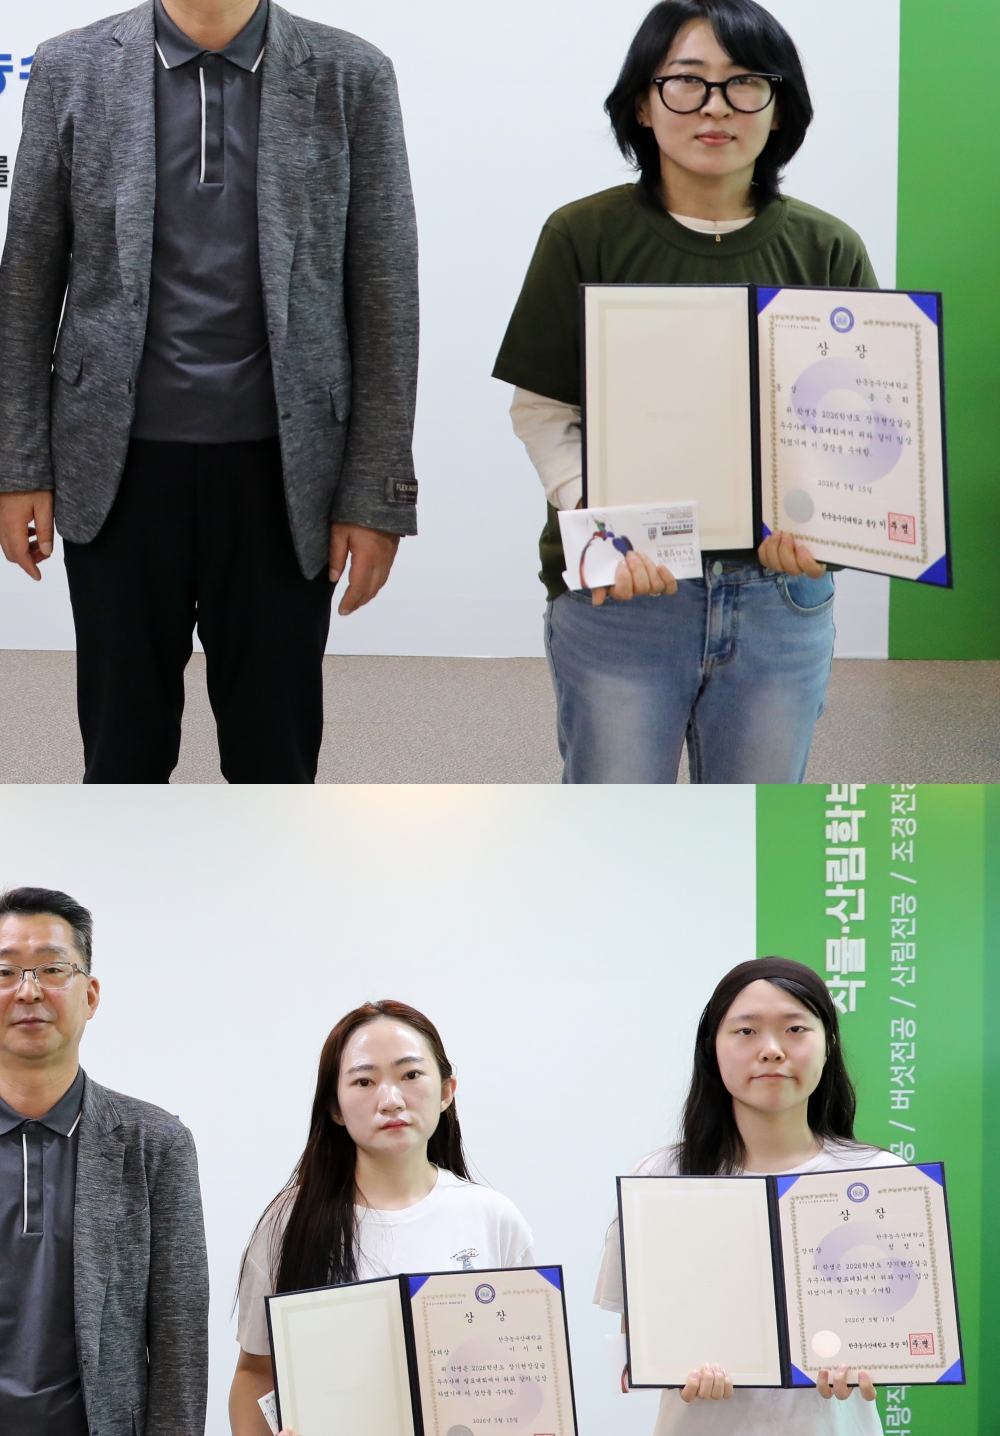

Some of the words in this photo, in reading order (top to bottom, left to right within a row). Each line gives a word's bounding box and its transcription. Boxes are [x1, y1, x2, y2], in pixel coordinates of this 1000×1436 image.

[817, 341, 829, 356] 상
[855, 344, 867, 359] 장
[891, 894, 917, 987] 산림전공
[890, 1017, 916, 1110] 버섯전공
[839, 1210, 850, 1221] 상
[875, 1207, 886, 1219] 장
[464, 1311, 474, 1323] 상
[496, 1310, 506, 1321] 장
